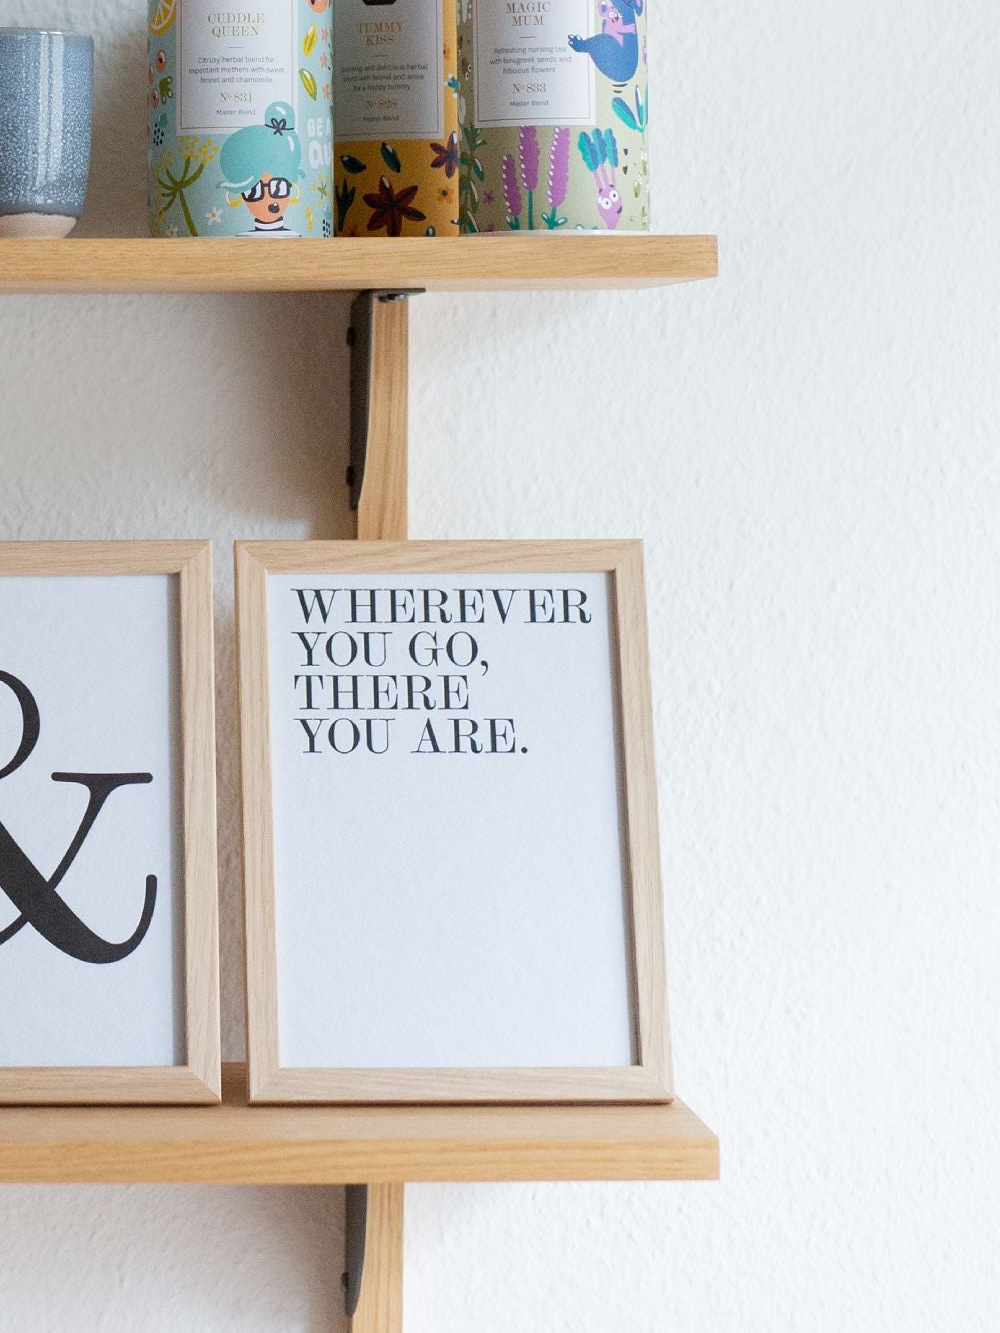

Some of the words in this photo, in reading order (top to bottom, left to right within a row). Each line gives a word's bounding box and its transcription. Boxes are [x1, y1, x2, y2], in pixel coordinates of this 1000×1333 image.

[506, 1, 551, 13] MAGIC
[208, 13, 265, 24] CUDDLE
[512, 15, 544, 27] MUM
[212, 26, 260, 38] QUEEN
[494, 47, 527, 55] Refreshing
[528, 46, 554, 54] nursing
[537, 55, 557, 63] seeds
[189, 67, 219, 75] expectant
[290, 587, 592, 624] WHEREVER
[291, 630, 393, 668] YOU
[408, 630, 490, 677] GO,
[293, 674, 471, 711] THERE
[293, 717, 396, 755] YOU
[409, 716, 530, 755] ARE.
